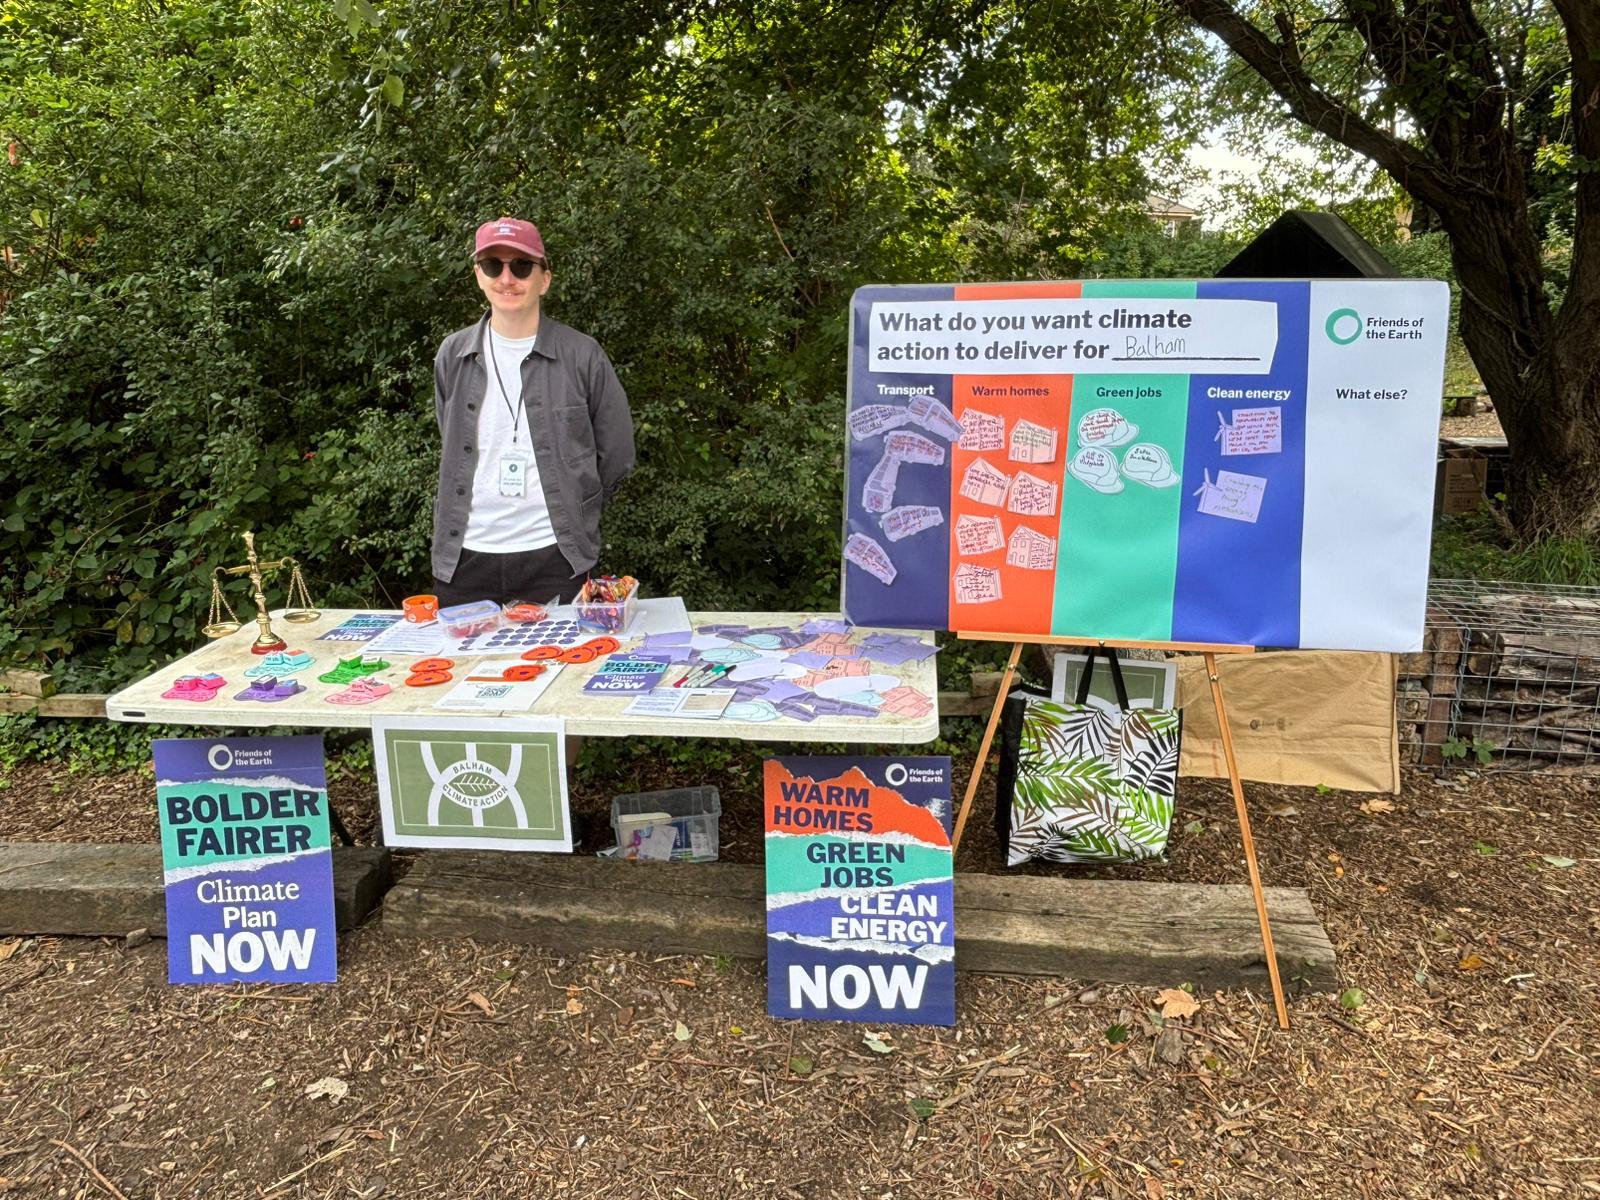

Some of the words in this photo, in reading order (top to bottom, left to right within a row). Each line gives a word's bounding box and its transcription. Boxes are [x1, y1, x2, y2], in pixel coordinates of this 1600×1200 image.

[879, 312, 943, 332] What
[948, 311, 977, 331] do
[982, 315, 1025, 334] you
[1032, 309, 1093, 330] want
[1098, 308, 1193, 329] climate
[1366, 317, 1410, 328] Friends
[1412, 317, 1425, 328] of
[1365, 329, 1386, 340] the
[1388, 329, 1422, 340] Earth
[877, 341, 949, 361] action
[955, 341, 979, 361] to
[984, 340, 1068, 361] deliver
[1073, 339, 1110, 359] for
[1125, 335, 1186, 359] Balham
[877, 384, 935, 397] Transport
[971, 385, 1007, 396] Warm
[1009, 385, 1050, 397] homes
[1096, 386, 1133, 398] Green
[1136, 386, 1162, 400] jobs
[1207, 387, 1243, 399] Clean
[1245, 389, 1291, 401] energy
[1335, 388, 1371, 400] What
[1373, 388, 1408, 400] else?
[234, 749, 262, 758] Friends
[263, 749, 273, 757] of
[234, 758, 249, 767] the
[249, 757, 273, 766] Earth
[453, 761, 492, 775] BALHAM
[909, 768, 935, 776] Friends
[936, 768, 943, 776] of
[909, 775, 921, 783] the
[922, 775, 943, 783] Earth
[442, 783, 479, 807] CLIMATE
[480, 785, 509, 807] ACTION
[780, 781, 870, 809] WARM
[166, 789, 321, 825] BOLDER
[773, 805, 874, 833] HOMES
[176, 824, 312, 857] FAIRER
[806, 841, 906, 864] GREEN
[820, 866, 894, 889] JOBS
[196, 878, 300, 904] Climate
[840, 892, 938, 917] CLEAN
[222, 906, 277, 929] Plan
[831, 916, 948, 944] ENERGY
[189, 928, 317, 975] NOW
[788, 964, 929, 1010] NOW
